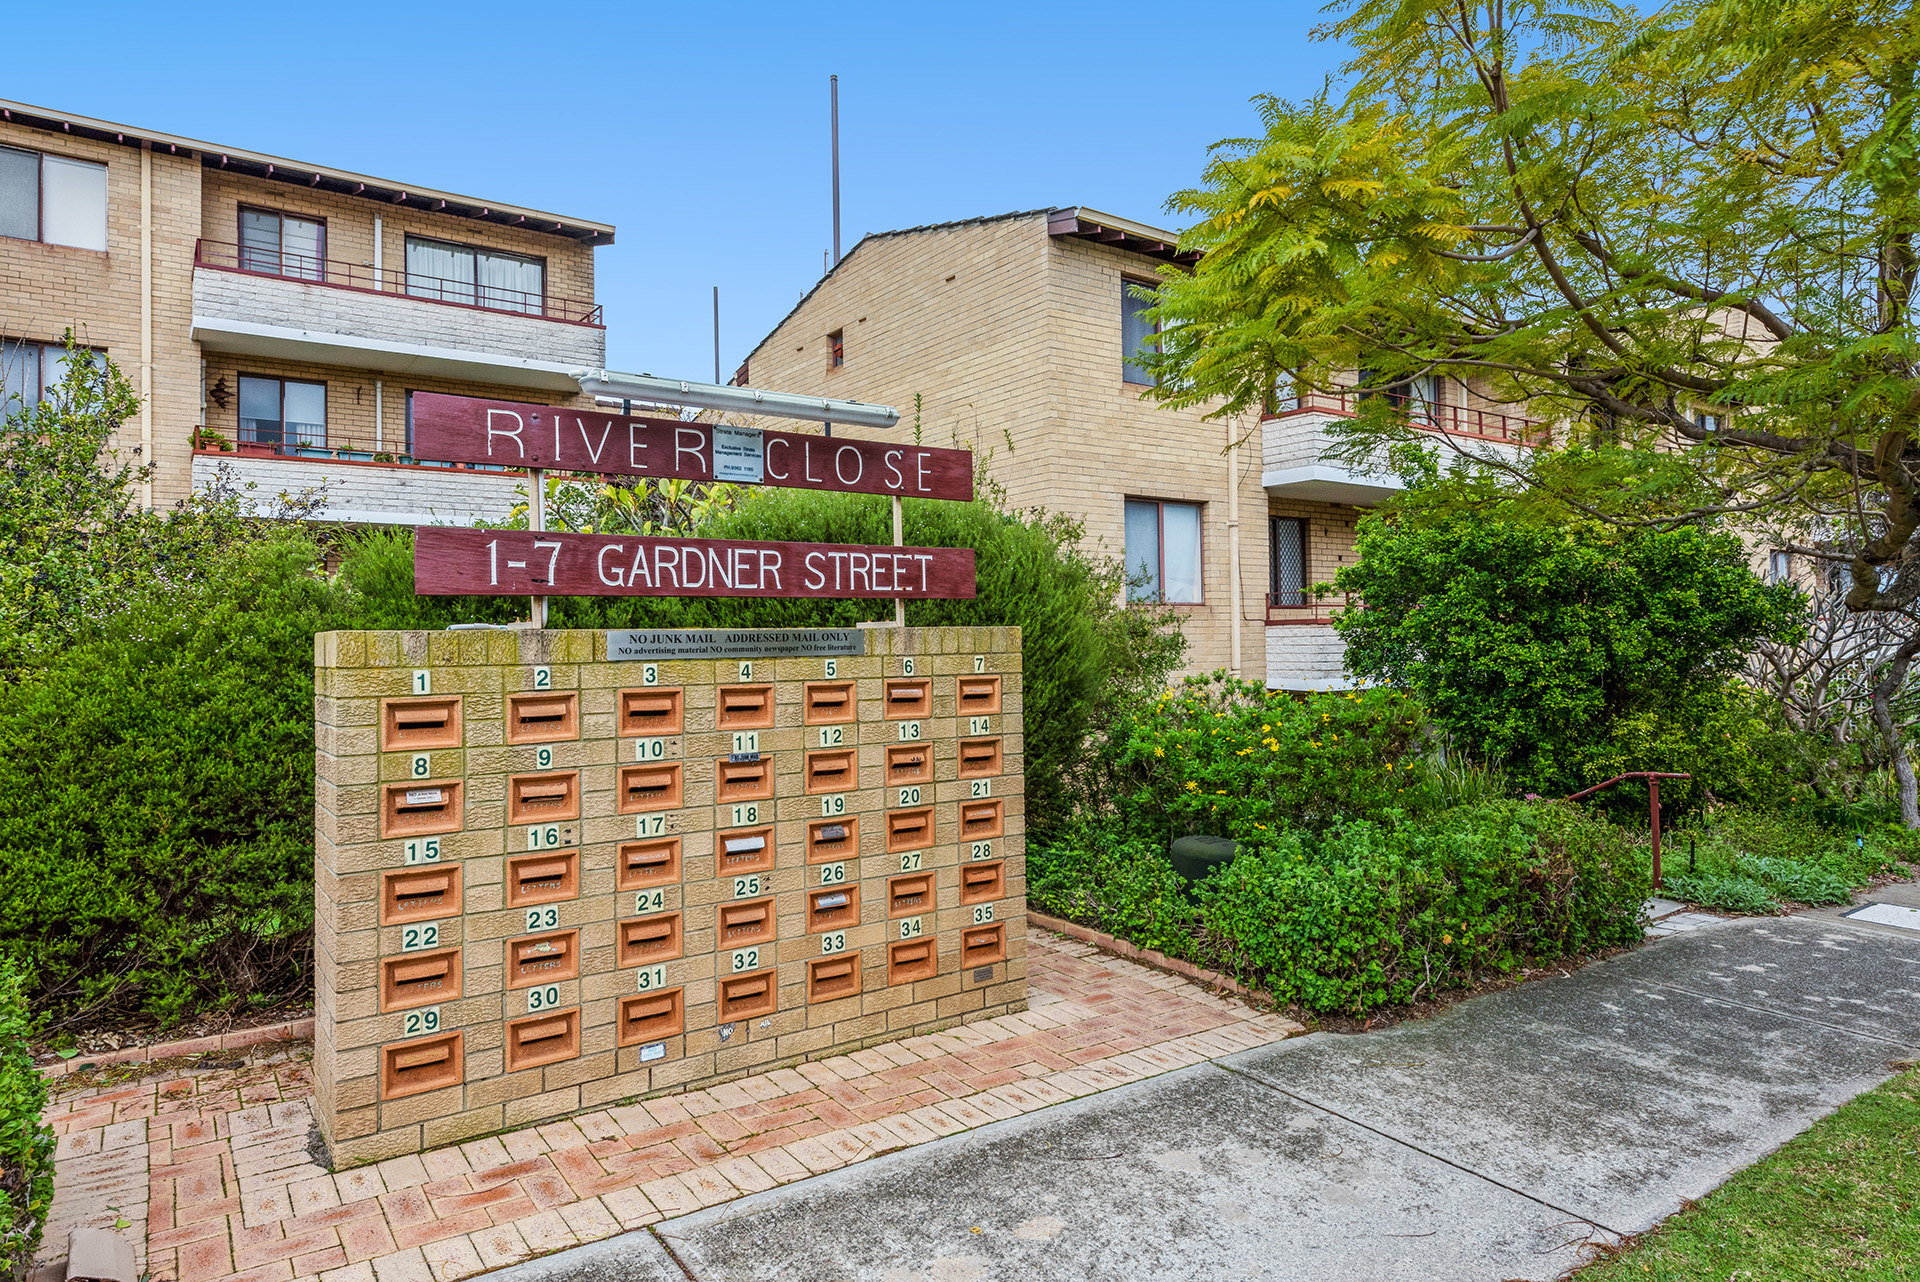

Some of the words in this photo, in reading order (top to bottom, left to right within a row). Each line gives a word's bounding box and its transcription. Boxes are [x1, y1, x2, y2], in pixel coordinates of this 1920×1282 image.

[487, 408, 707, 474] RIVER
[766, 438, 932, 492] CLOSE
[485, 539, 563, 586] 1-7
[597, 544, 783, 589] GARDNER
[804, 551, 934, 592] STREET
[629, 634, 648, 645] NO
[650, 634, 683, 644] JUNK
[685, 633, 717, 644] MAIL
[724, 633, 789, 643] ADDRESSED
[791, 632, 820, 642] MAIL
[821, 632, 850, 642] ONLY
[618, 647, 632, 655] NO
[633, 646, 676, 655] advertising
[677, 646, 709, 654] material
[710, 645, 723, 653] NO
[724, 644, 762, 654] community
[764, 644, 800, 654] newspaper
[801, 644, 812, 652] NO
[813, 643, 826, 651] free
[827, 643, 857, 651] literature
[741, 664, 751, 679] 4
[826, 661, 836, 677] 5
[904, 659, 913, 674] 6
[975, 657, 984, 671] 7
[417, 673, 425, 692] 1
[536, 669, 549, 687] 2
[645, 666, 656, 683] 3
[900, 723, 919, 738] 13
[972, 719, 989, 733] 14
[735, 734, 755, 751] 11
[821, 728, 842, 745] 12
[538, 748, 551, 767] 9
[638, 740, 663, 758] 10
[414, 757, 428, 776] 8
[901, 788, 920, 804] 20
[972, 781, 988, 796] 21
[734, 806, 757, 823] 18
[823, 797, 844, 814] 19
[639, 816, 664, 835] 17
[530, 827, 558, 847] 16
[407, 840, 439, 861] 15
[973, 844, 991, 859] 28
[902, 853, 921, 870] 27
[822, 865, 844, 883] 26
[736, 878, 759, 896] 25
[637, 892, 662, 912] 24
[528, 909, 557, 929] 23
[974, 904, 993, 922] 35
[901, 919, 921, 937] 34
[404, 926, 437, 949] 22
[823, 934, 845, 952] 33
[734, 950, 758, 969] 32
[639, 968, 662, 989] 31
[530, 987, 558, 1009] 30
[407, 1011, 438, 1034] 29
